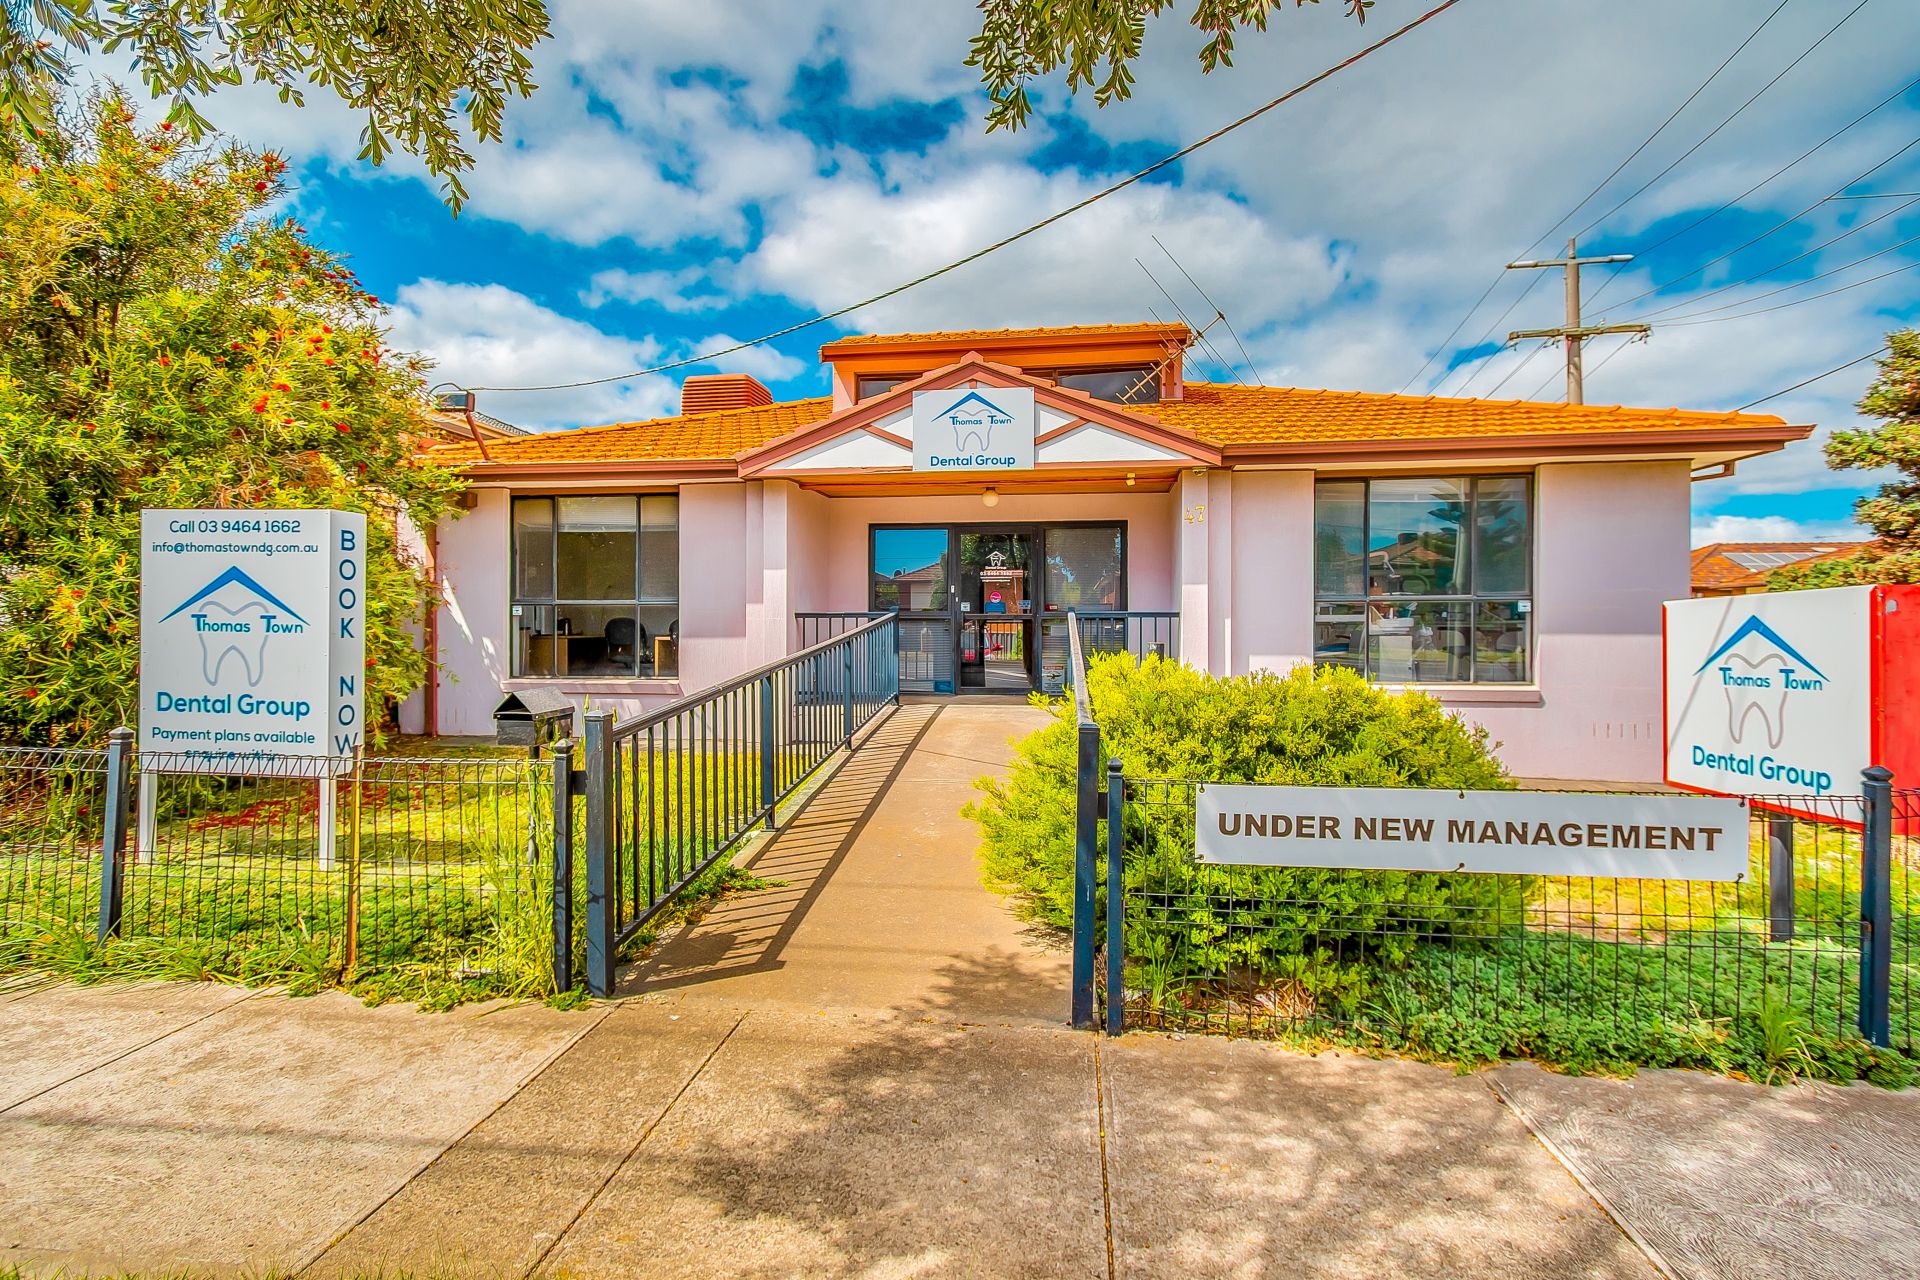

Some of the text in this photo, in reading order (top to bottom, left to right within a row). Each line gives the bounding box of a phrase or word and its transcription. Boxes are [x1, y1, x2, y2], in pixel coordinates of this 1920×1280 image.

[949, 415, 1012, 426] Thomas Town
[930, 455, 1016, 468] Dental Group
[169, 520, 301, 533] Call 03 9464 1662
[152, 542, 319, 556] info@thomastowndg.com.au
[338, 529, 357, 639] BOOK
[191, 614, 304, 634] Thomas Town
[1718, 667, 1823, 691] Thomas Town
[156, 692, 310, 721] Dental Group
[152, 727, 316, 744] Payment plans available
[1693, 745, 1832, 796] Dental Group
[1218, 813, 1723, 851] UNDER NEW MANAGEMENT
